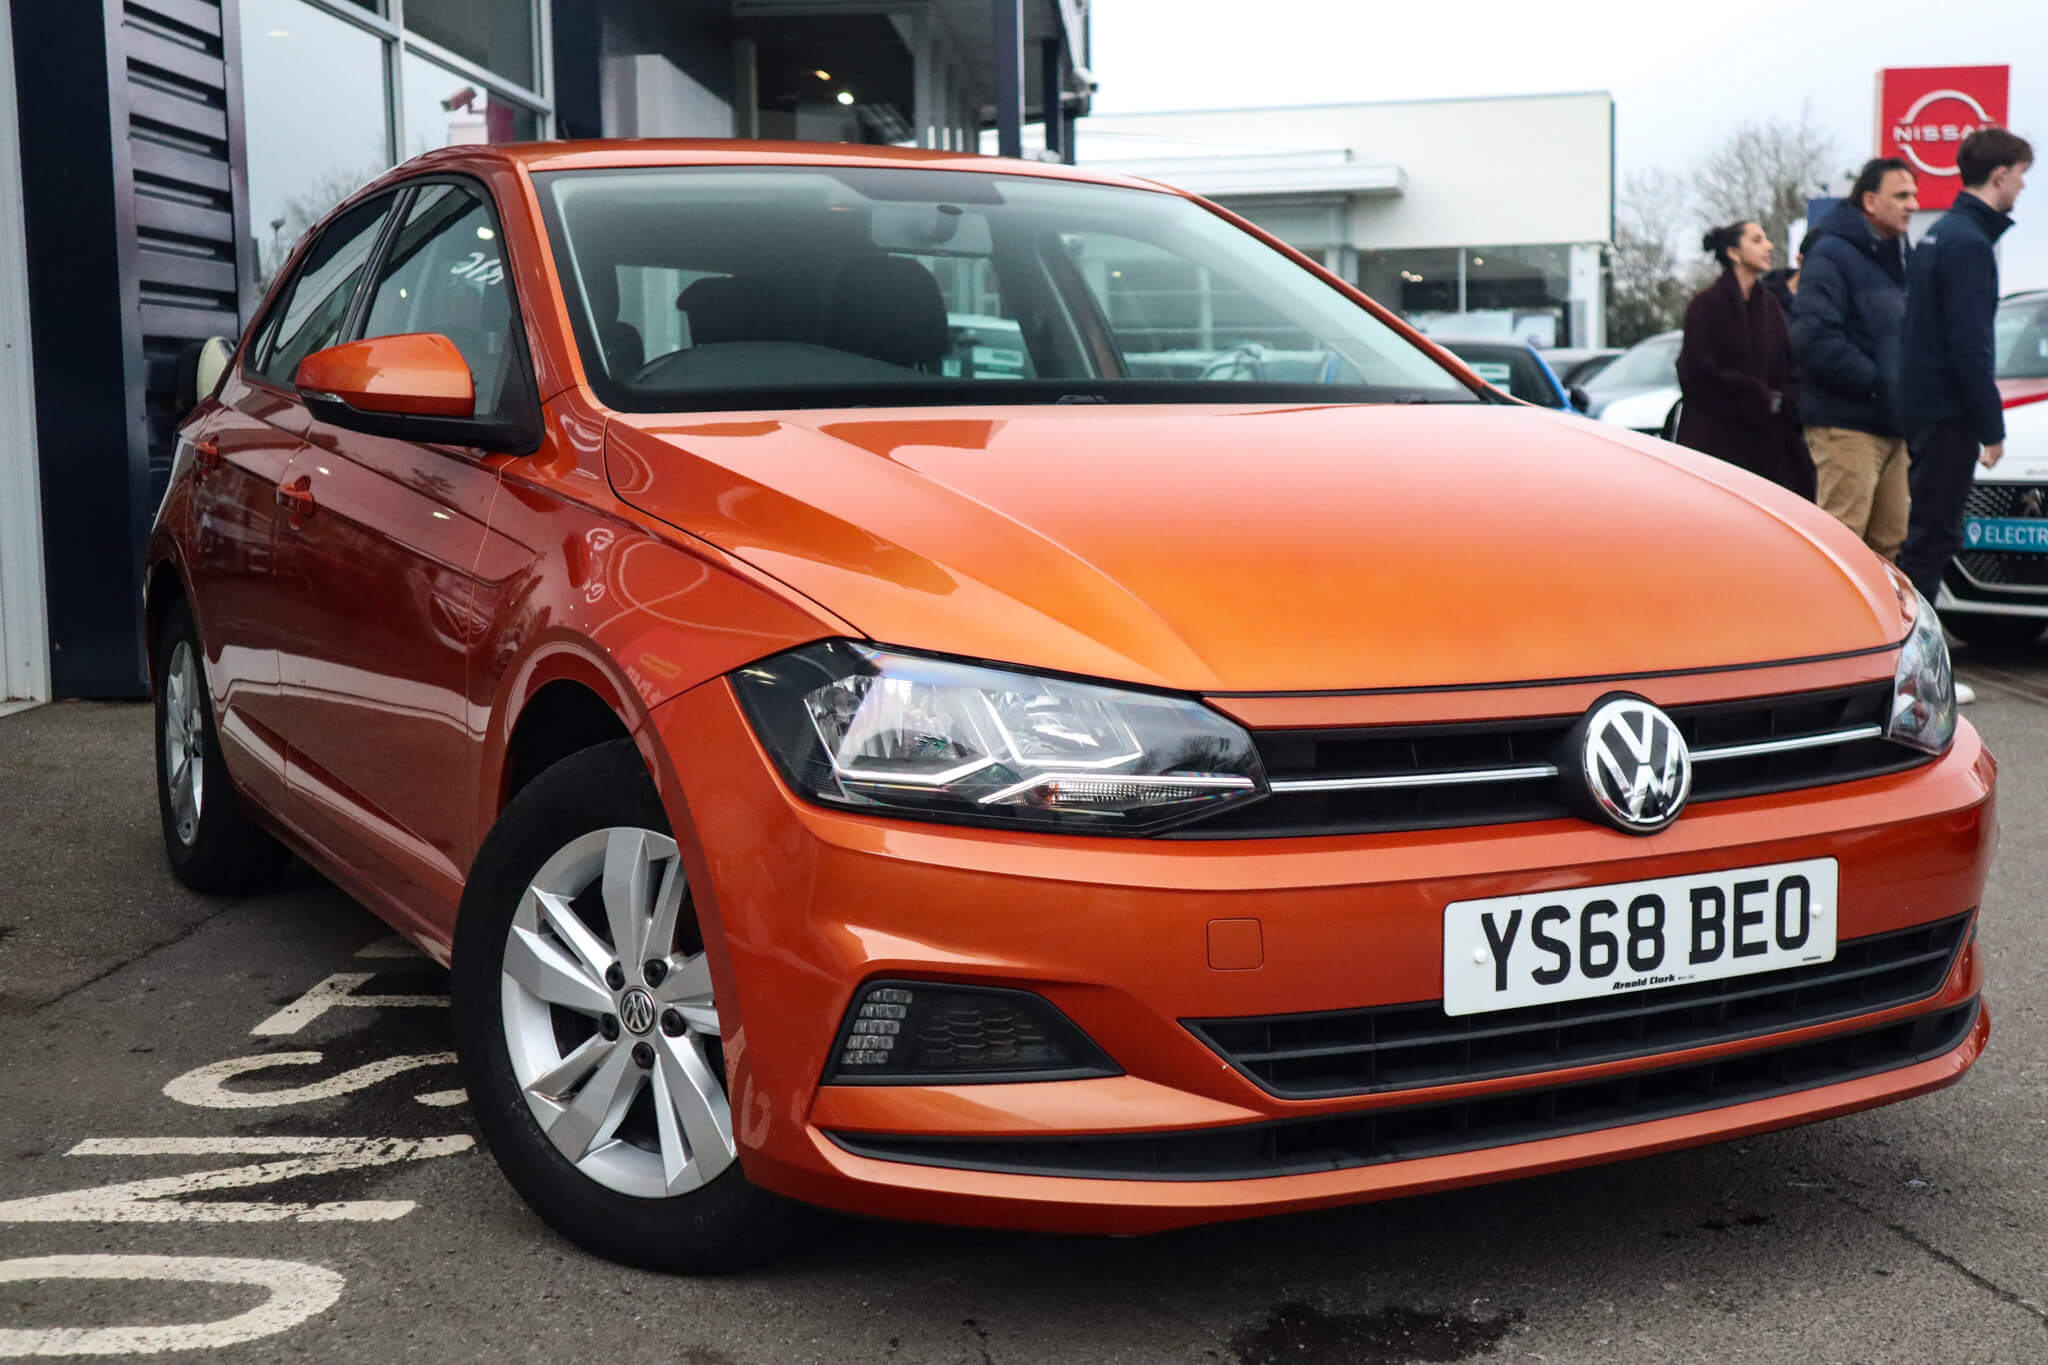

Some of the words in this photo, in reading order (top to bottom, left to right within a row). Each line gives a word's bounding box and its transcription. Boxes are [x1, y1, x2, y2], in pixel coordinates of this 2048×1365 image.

[1893, 123, 2000, 142] NISSA
[1481, 893, 1665, 992] YS68
[1612, 978, 1647, 990] Arnold
[1649, 974, 1675, 985] Clark
